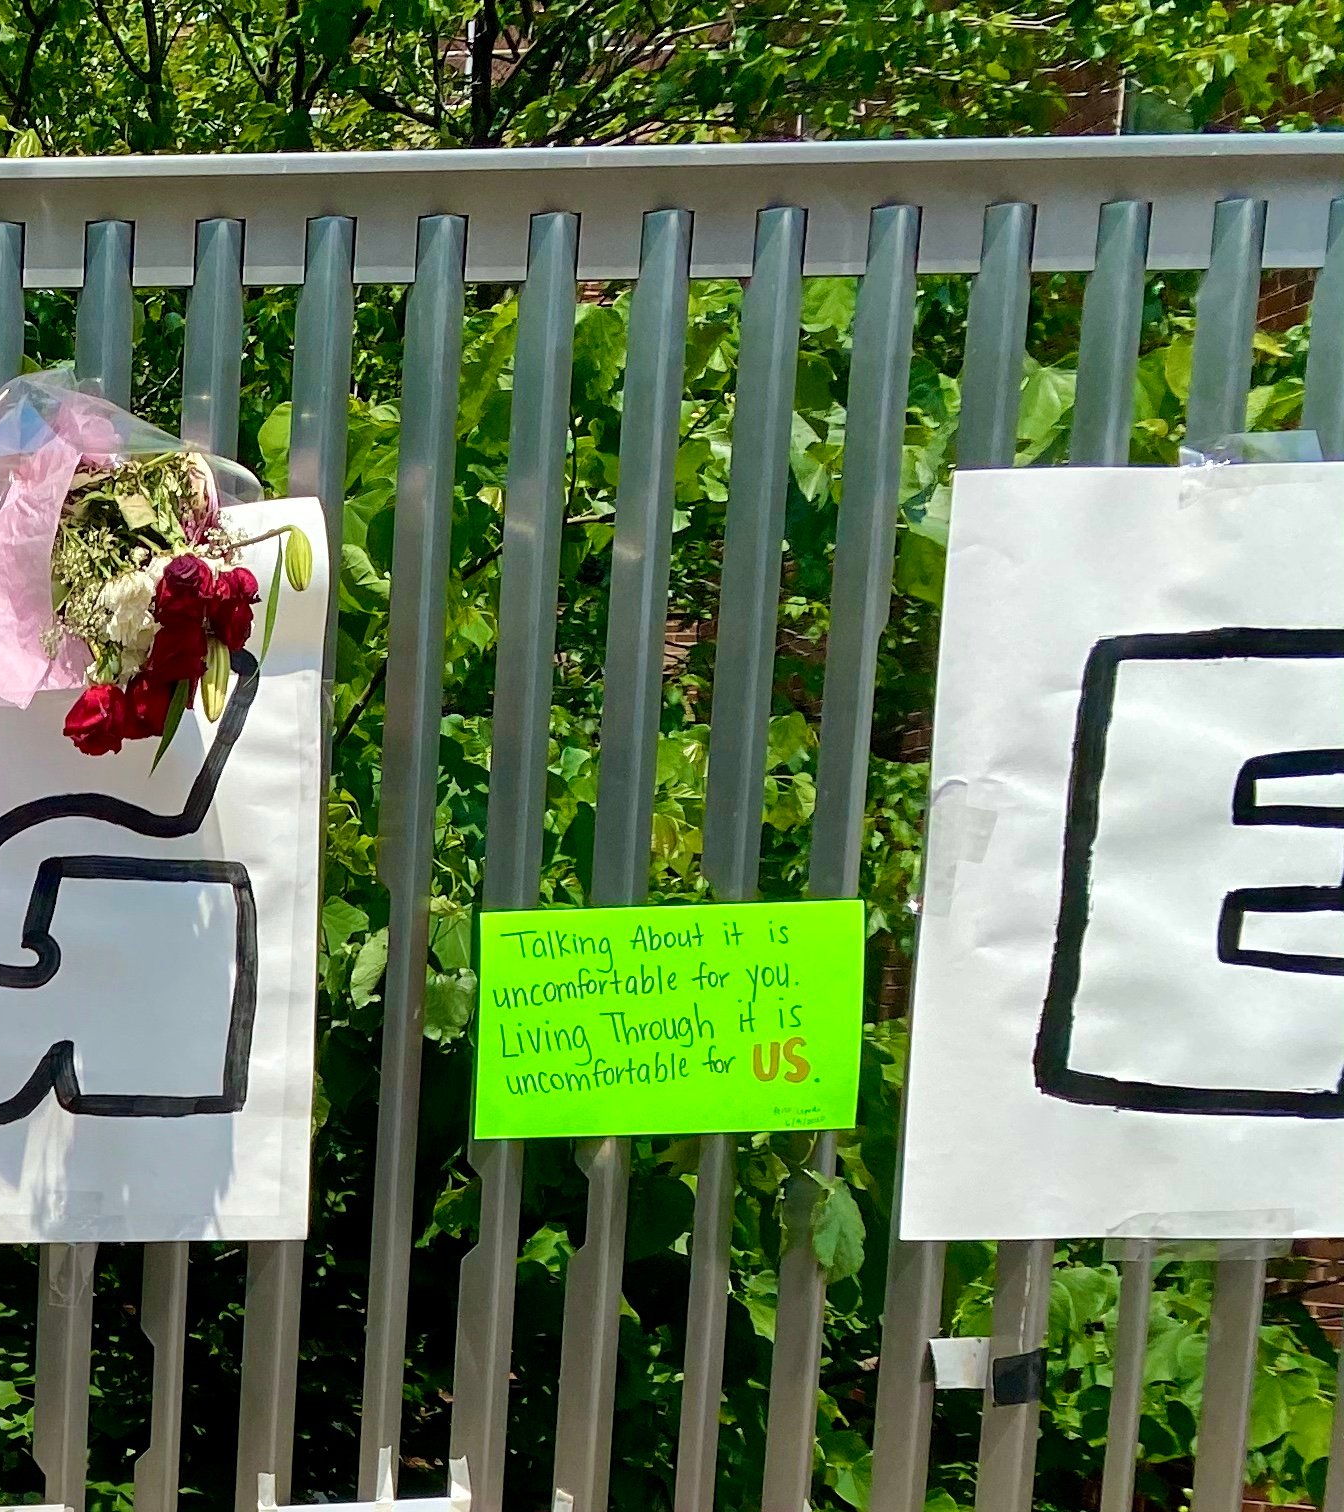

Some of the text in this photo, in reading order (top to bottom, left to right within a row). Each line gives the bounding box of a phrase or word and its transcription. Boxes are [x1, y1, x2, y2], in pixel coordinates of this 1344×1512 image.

[1033, 627, 1344, 1117] E
[500, 921, 789, 973] Talking About it is
[492, 962, 800, 1010] uncomfortable for you.
[500, 997, 802, 1067] Living Through it is
[506, 1045, 736, 1096] uncomfortable for
